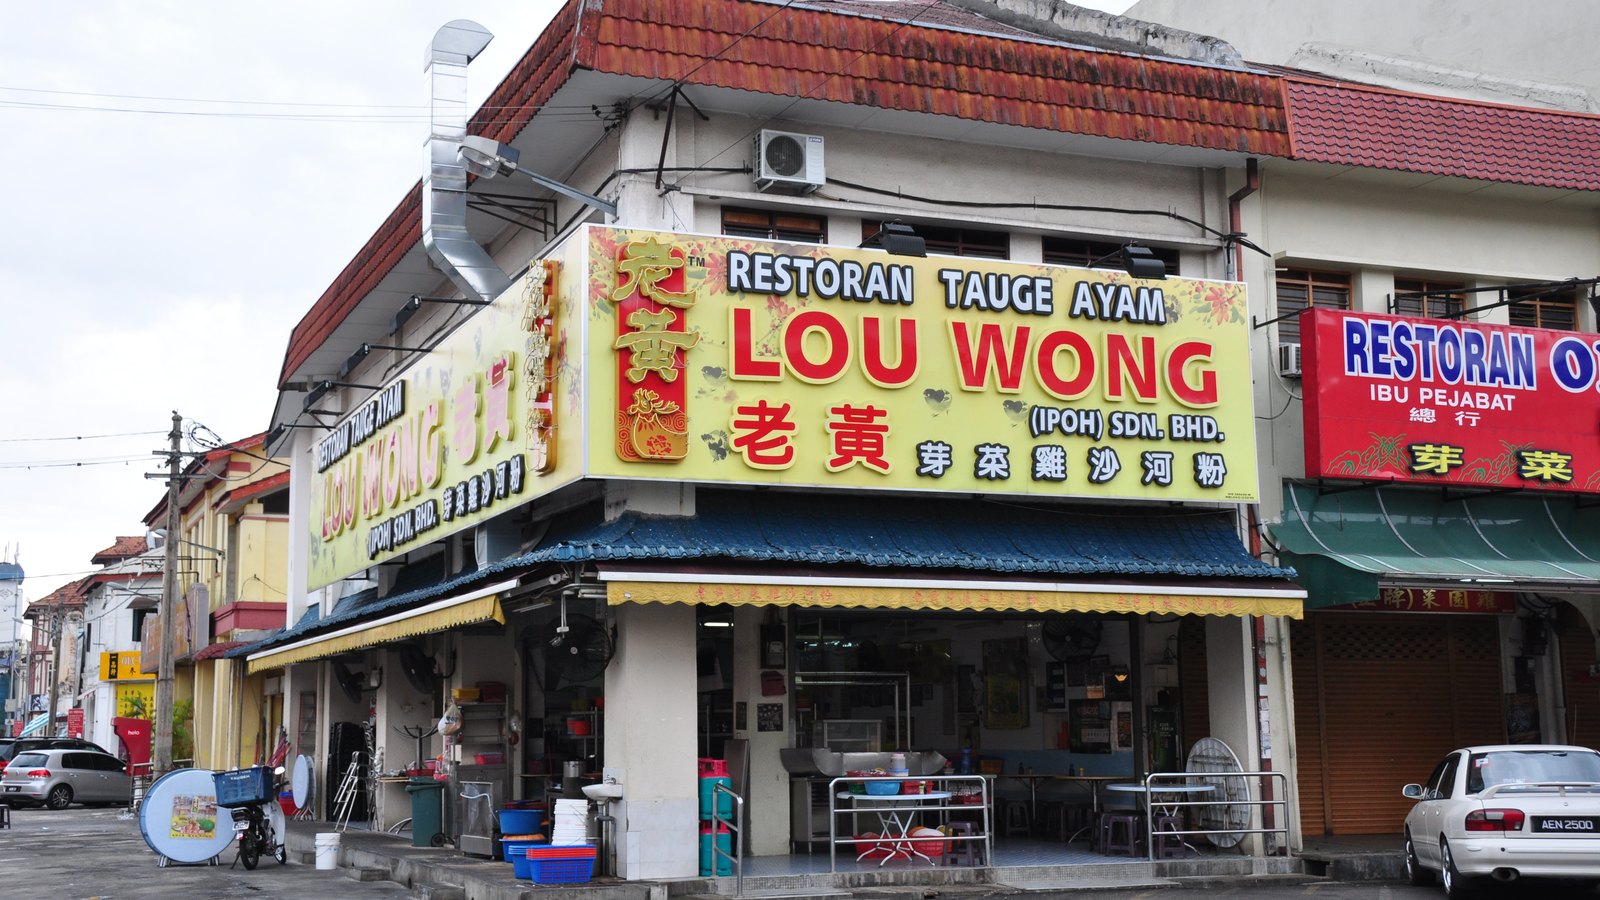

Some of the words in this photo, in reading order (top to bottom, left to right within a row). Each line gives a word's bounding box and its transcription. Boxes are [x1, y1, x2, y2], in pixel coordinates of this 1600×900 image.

[688, 256, 705, 267] TM
[727, 251, 914, 306] RESTORAN
[940, 269, 1053, 315] TAUGE
[1070, 281, 1166, 324] AYAM
[733, 308, 917, 386] LOU
[952, 320, 1219, 407] WONG
[1343, 317, 1537, 392] RESTORAN
[1370, 384, 1410, 404] IBU
[1420, 387, 1516, 411] PEJABAT
[1409, 407, 1481, 427] 總行
[318, 421, 351, 473] RESTORAN
[348, 400, 377, 448] TAUGE
[375, 379, 406, 430] AYAM
[733, 400, 890, 472] 老黃
[1030, 406, 1104, 441] (IPOH)
[1109, 409, 1165, 440] SDN.
[1170, 411, 1226, 443] BHD.
[321, 451, 358, 541] LOU
[361, 399, 442, 519] WONG
[916, 440, 1228, 490] 芽菜雞沙河粉
[1409, 443, 1575, 484] 芽菜
[393, 512, 415, 546] SDN.
[415, 498, 440, 538] BHD.
[1541, 819, 1564, 830] AEN
[1564, 819, 1594, 830] 2500
